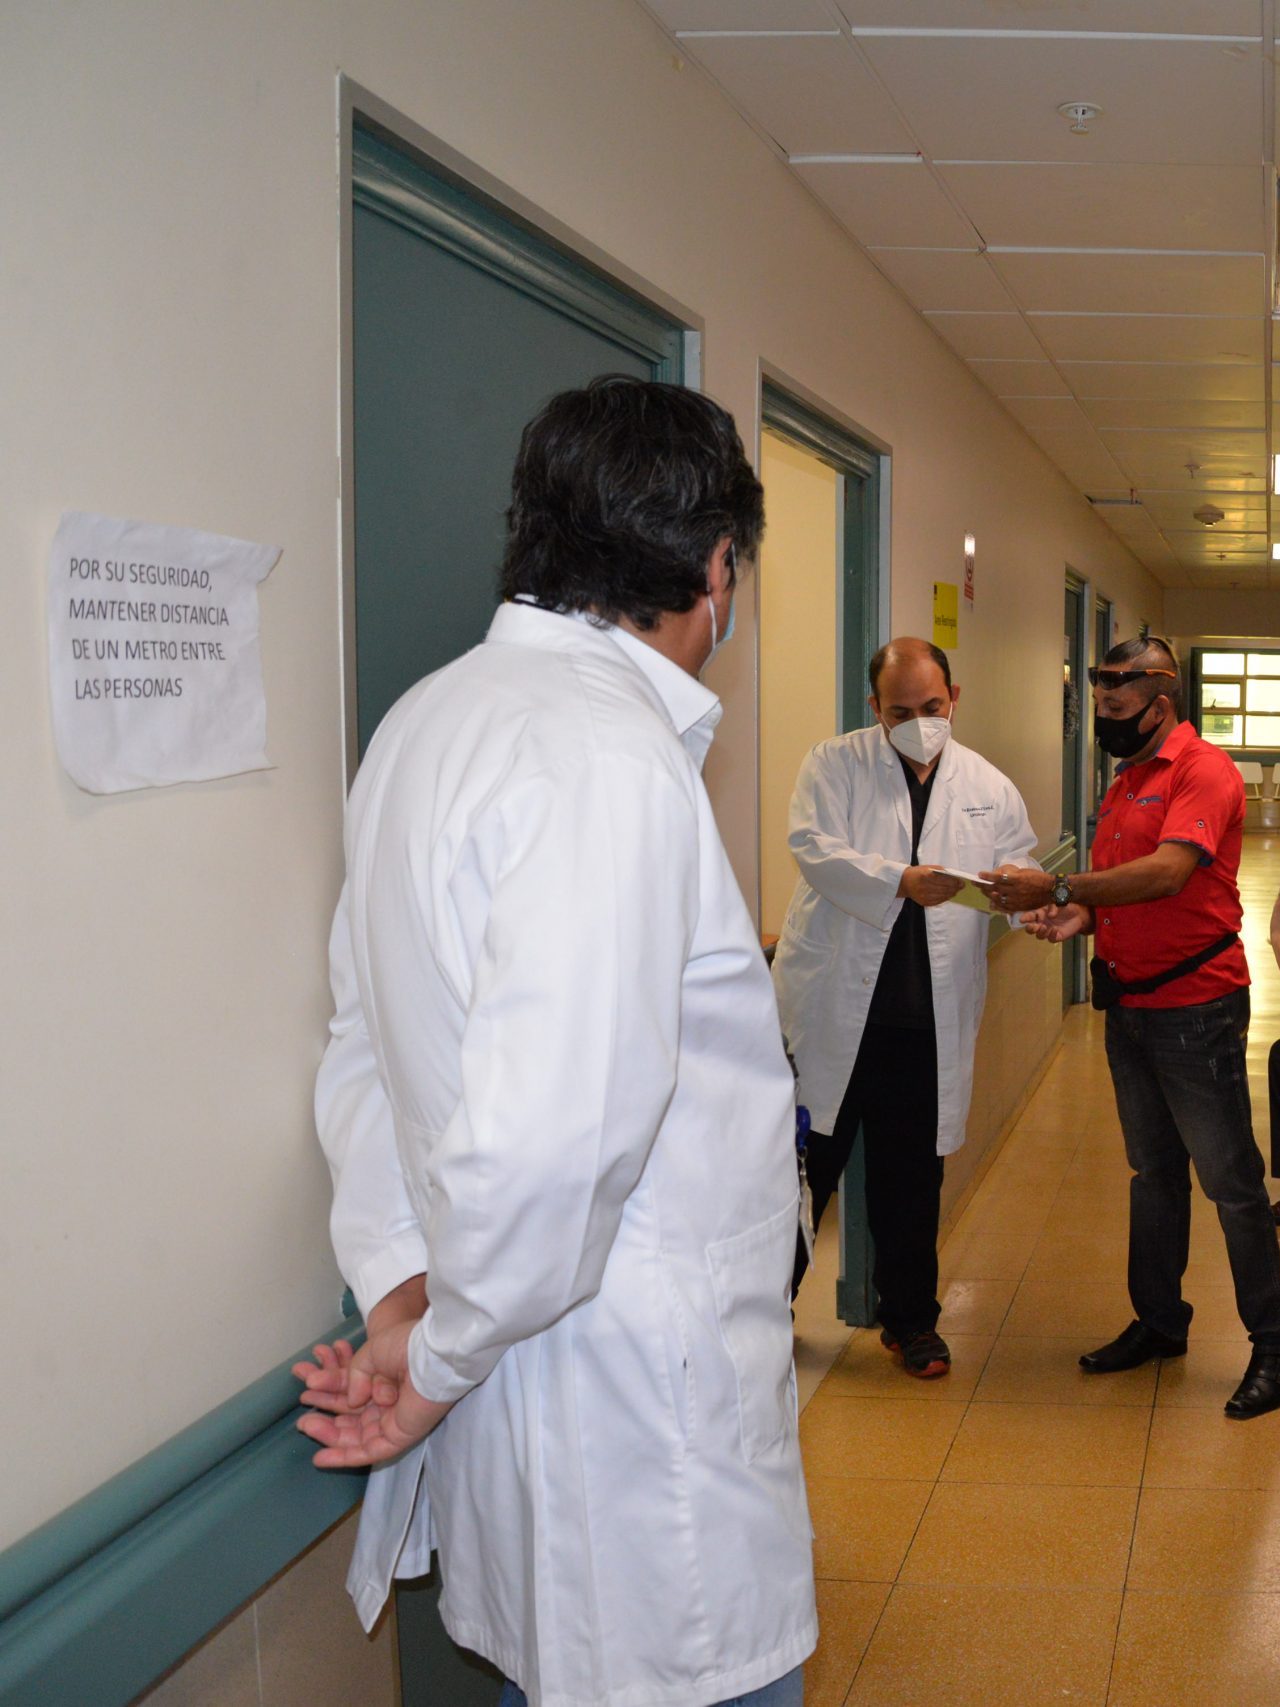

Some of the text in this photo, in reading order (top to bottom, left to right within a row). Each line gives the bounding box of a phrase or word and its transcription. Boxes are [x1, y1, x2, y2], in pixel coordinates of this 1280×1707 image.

[70, 557, 212, 592] POR SU SEGURIDAD,
[69, 598, 229, 626] MANTENER DISTANCIA
[72, 638, 226, 661] DE UN METRO ENTRE
[75, 677, 183, 700] LAS PERSONAS
